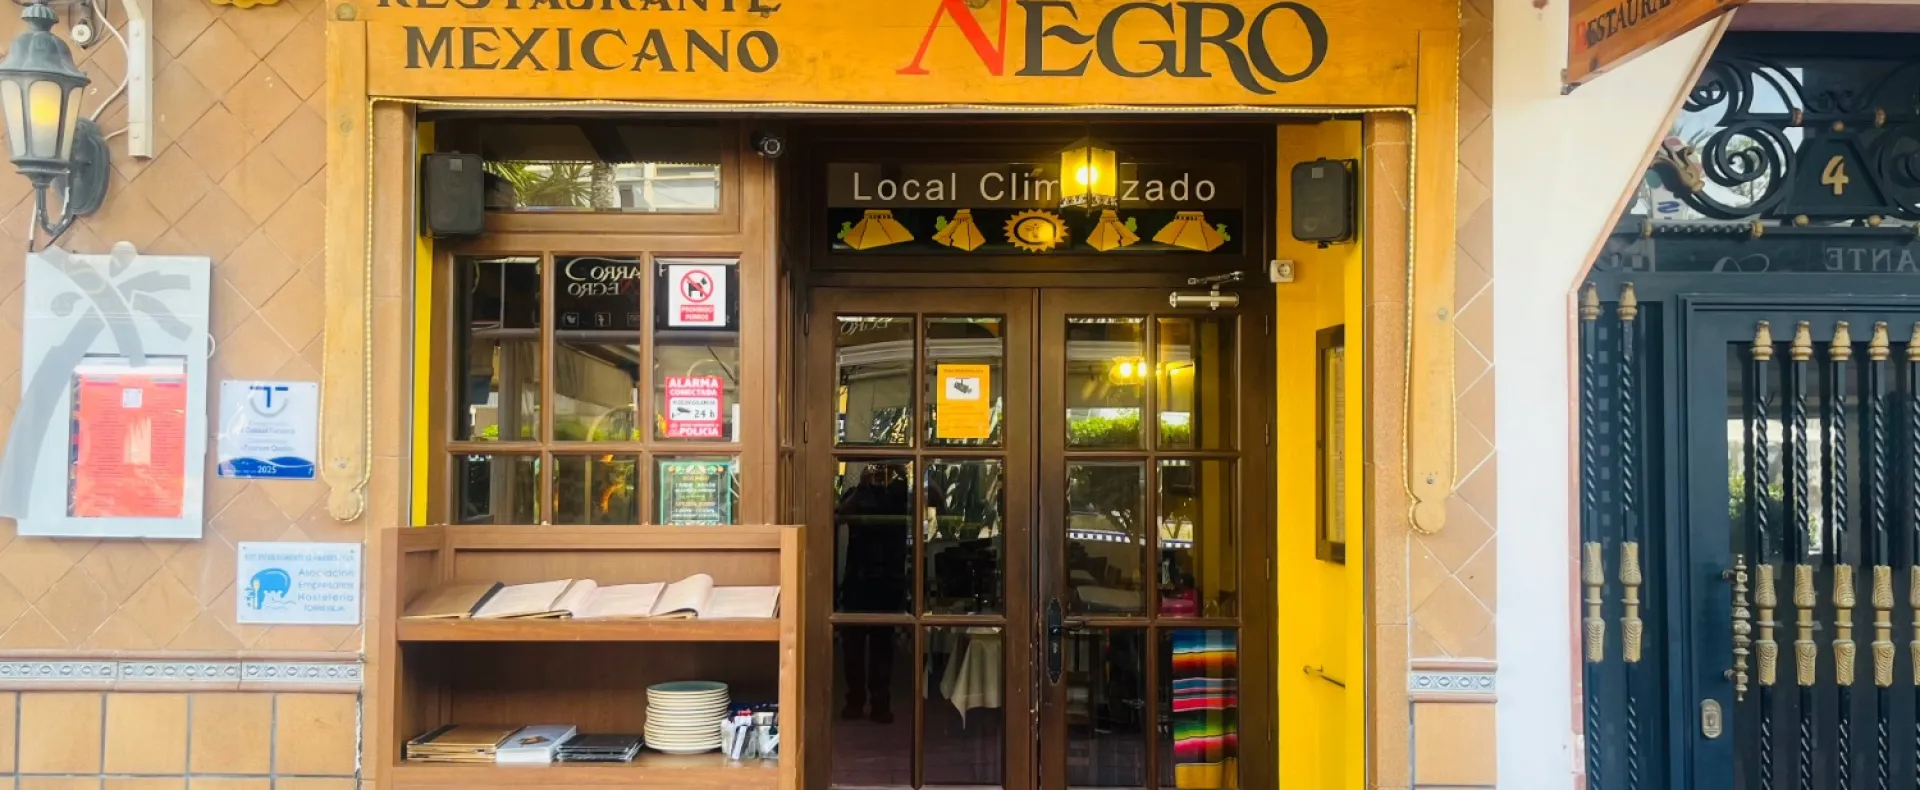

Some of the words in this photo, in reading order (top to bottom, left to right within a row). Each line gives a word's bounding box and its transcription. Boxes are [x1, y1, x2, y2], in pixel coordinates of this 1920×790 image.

[403, 25, 780, 73] MEXICANO
[895, 0, 1329, 95] NEGRO
[853, 172, 957, 202] Local
[979, 172, 1216, 202] Climzado
[1822, 155, 1849, 195] 4
[668, 378, 719, 388] ALARMA
[694, 409, 706, 419] 24
[256, 465, 278, 474] 2025
